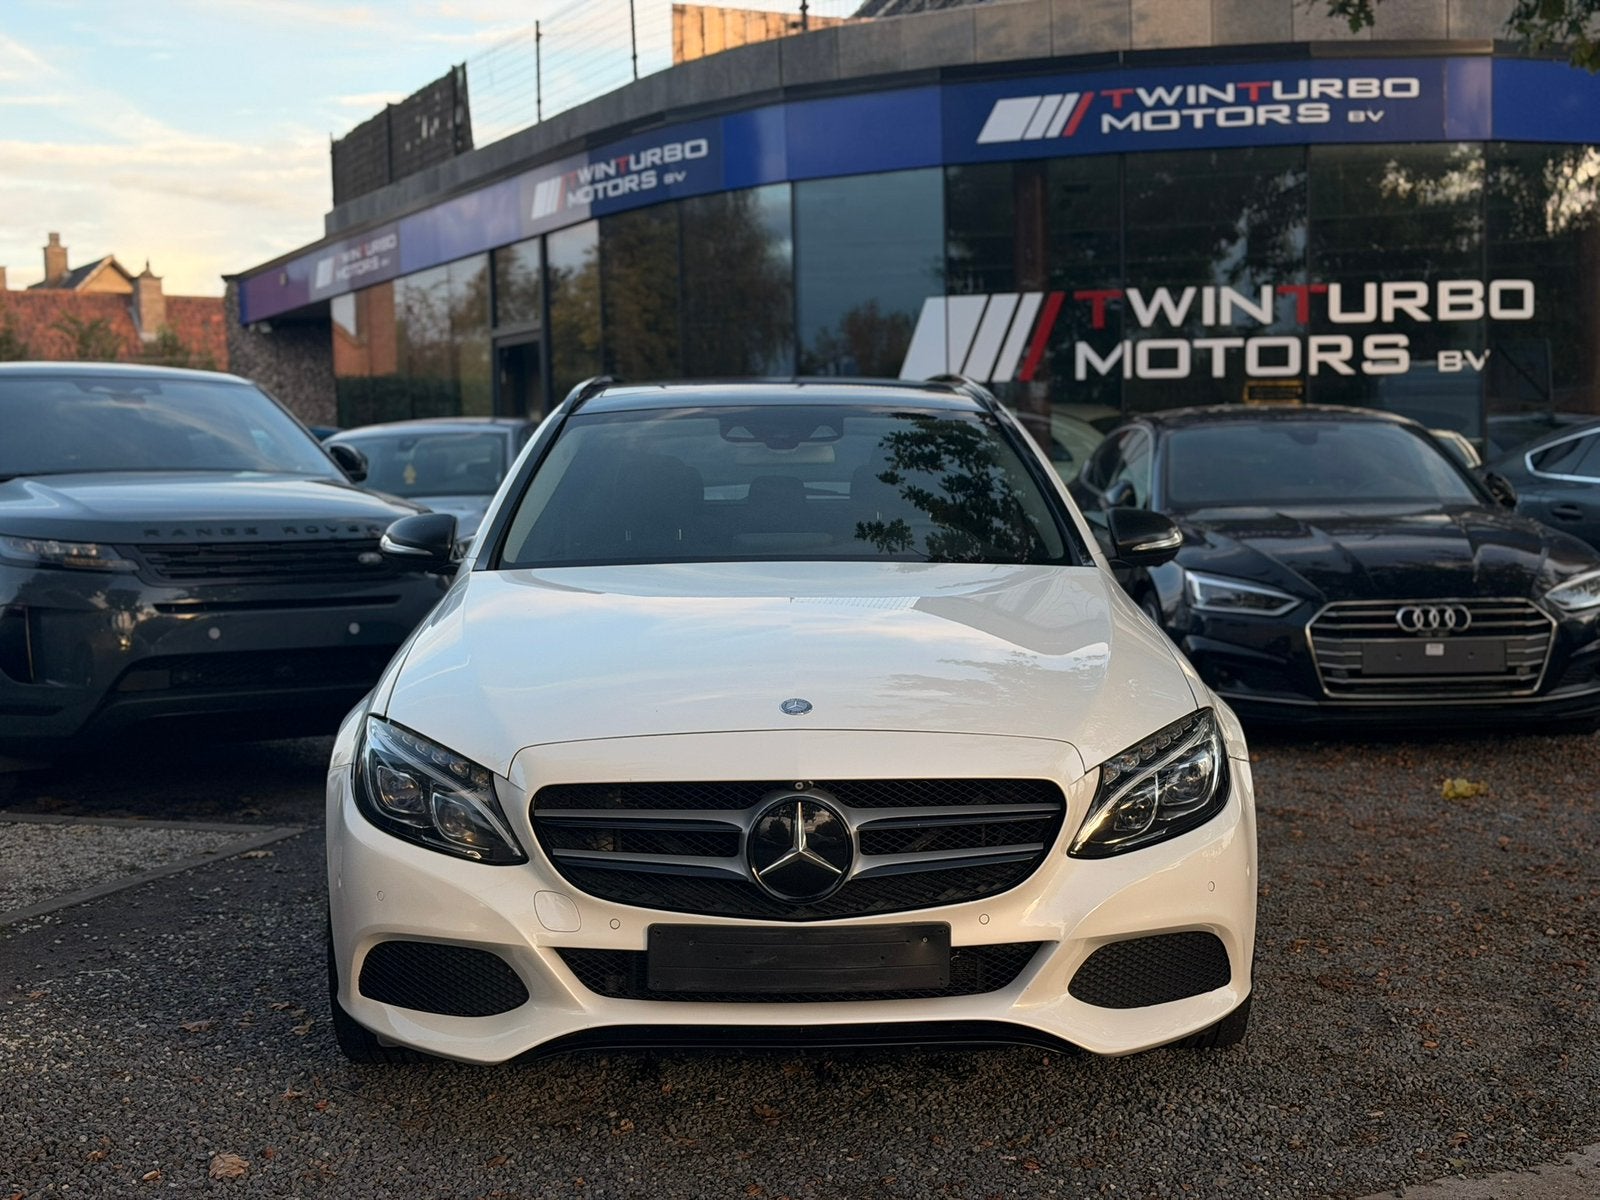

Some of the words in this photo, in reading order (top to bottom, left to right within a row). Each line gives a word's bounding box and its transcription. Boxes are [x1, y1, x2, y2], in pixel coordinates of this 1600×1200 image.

[1101, 77, 1420, 108] TWINTURBO
[1102, 103, 1331, 133] MOTORS
[1348, 109, 1385, 123] BV
[566, 138, 708, 185] TWINTURBO
[567, 170, 657, 208] MOTORS
[1074, 279, 1535, 328] TWINTURBO
[1075, 333, 1410, 380] MOTORS
[1437, 348, 1490, 372] BV
